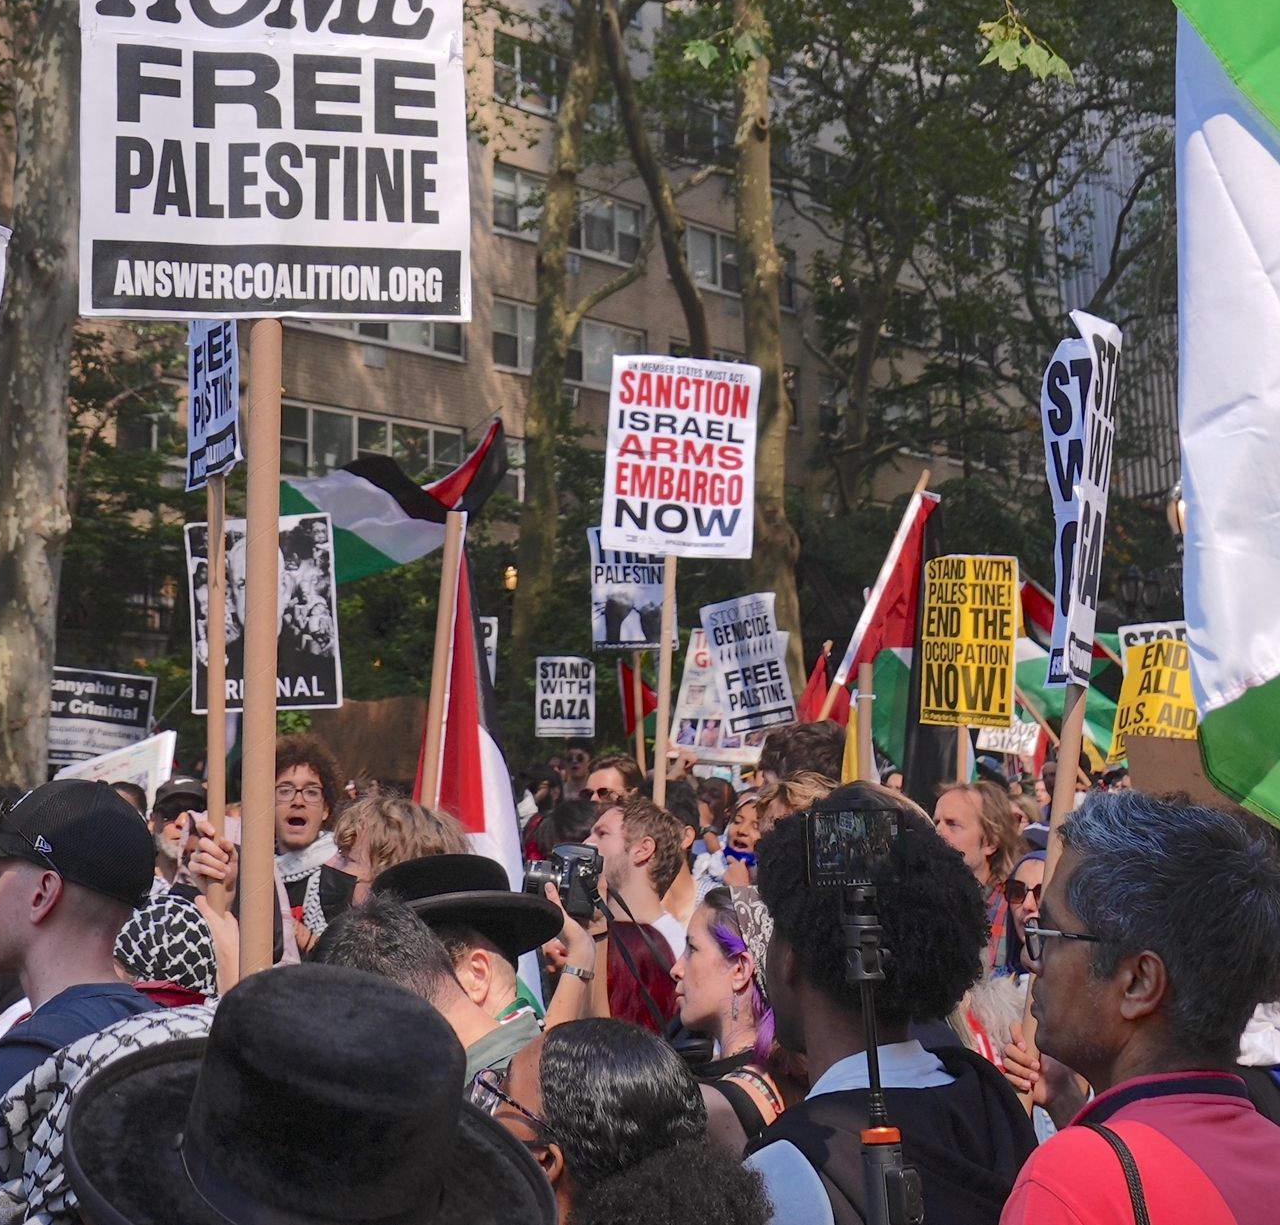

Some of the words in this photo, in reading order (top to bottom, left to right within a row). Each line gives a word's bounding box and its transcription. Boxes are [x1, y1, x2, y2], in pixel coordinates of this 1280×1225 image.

[117, 43, 439, 137] FREE
[115, 136, 440, 224] PALESTINE
[113, 259, 443, 303] ANSWERCOALITION.ORG
[640, 362, 675, 375] MEMBER
[676, 365, 703, 377] STATES
[704, 370, 727, 381] MUST
[618, 370, 751, 419] SANCTION
[618, 409, 744, 444] ISRAEL
[617, 434, 744, 471] ARMS
[615, 462, 743, 507] EMBARGO
[614, 498, 741, 537] NOW
[595, 565, 665, 584] PALESTIN
[928, 559, 966, 580] STAND
[973, 560, 1012, 582] WITH
[928, 582, 1011, 607] PALESTINE!
[926, 606, 961, 638] END
[969, 608, 1011, 641] THE
[925, 641, 1010, 666] OCCUPATION
[1141, 642, 1189, 671] END
[540, 662, 591, 679] STAND
[1138, 669, 1181, 698] ALL
[51, 679, 116, 696] anyahu
[120, 684, 135, 698] is
[139, 689, 149, 700] a
[225, 676, 325, 700] RINAL
[540, 680, 591, 695] WITH
[924, 663, 1007, 713] NOW!
[50, 700, 66, 712] ar
[68, 699, 138, 720] Criminal
[540, 698, 591, 720] GAZA
[1119, 702, 1149, 729] U.S.
[1157, 703, 1197, 731] AID
